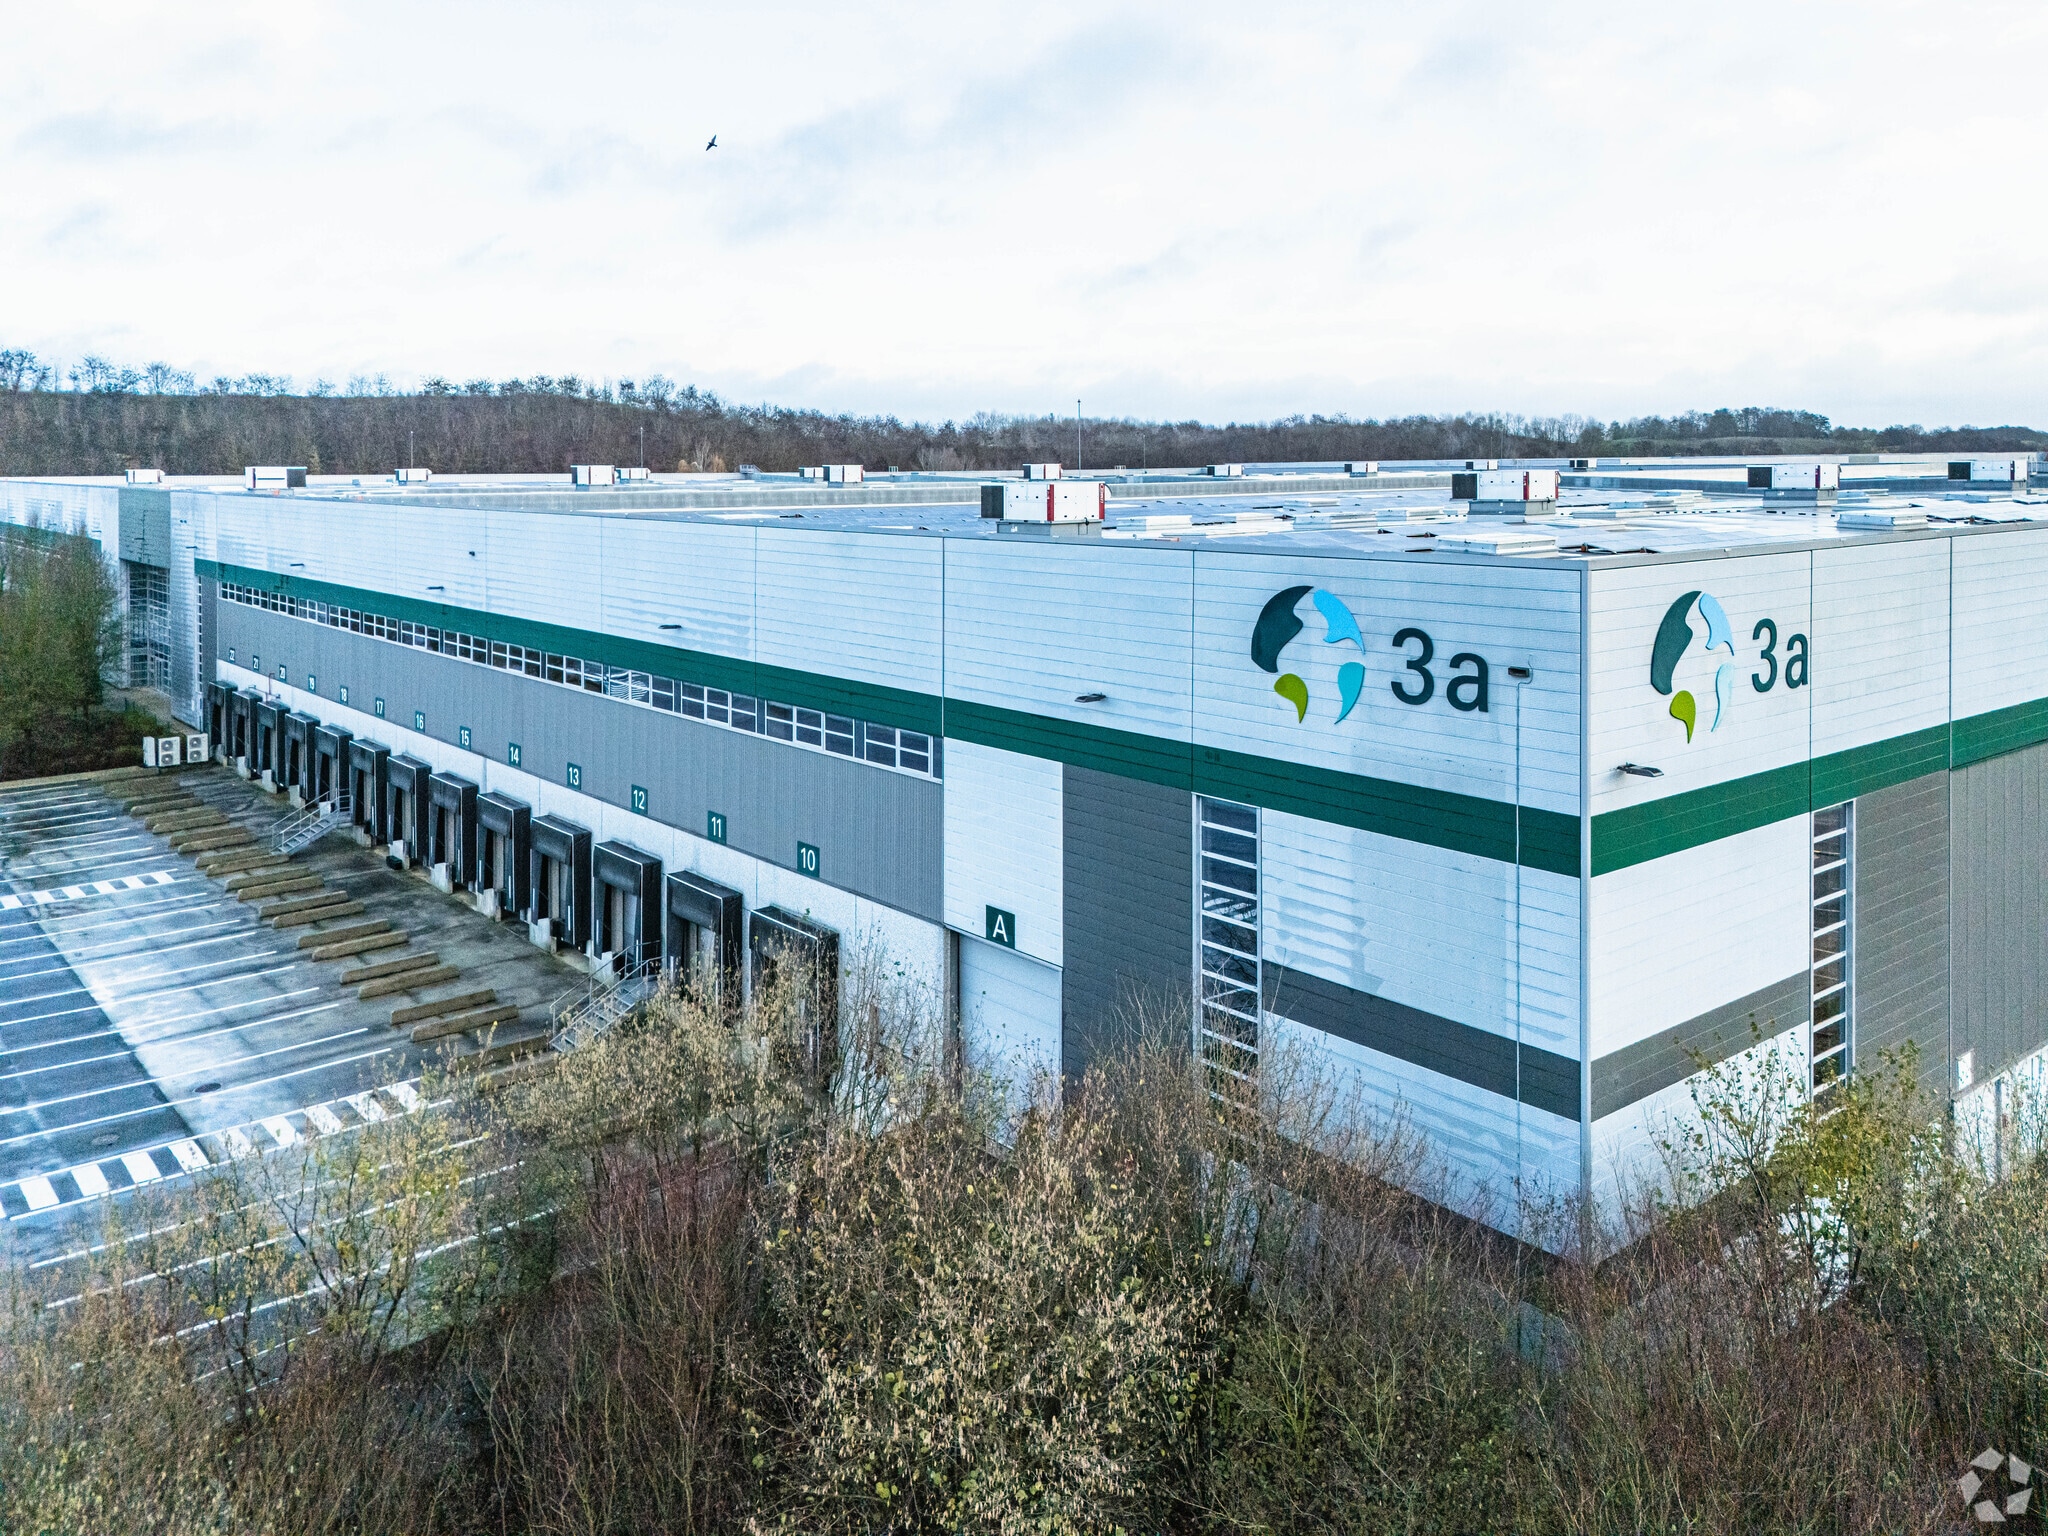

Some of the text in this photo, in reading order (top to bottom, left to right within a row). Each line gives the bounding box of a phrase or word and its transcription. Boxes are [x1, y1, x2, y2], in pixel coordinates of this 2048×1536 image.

[1751, 618, 1809, 693] 3a
[279, 667, 286, 679] 20
[1391, 627, 1489, 713] 3a
[308, 677, 315, 690] 19
[340, 688, 347, 702] 18
[376, 701, 383, 714] 17
[416, 714, 424, 729] 16
[461, 729, 469, 746] 15
[510, 747, 519, 764] 14
[568, 767, 579, 786] 13
[633, 789, 645, 810] 12
[711, 816, 721, 839] 11
[800, 847, 816, 872] 10
[992, 914, 1009, 942] A
